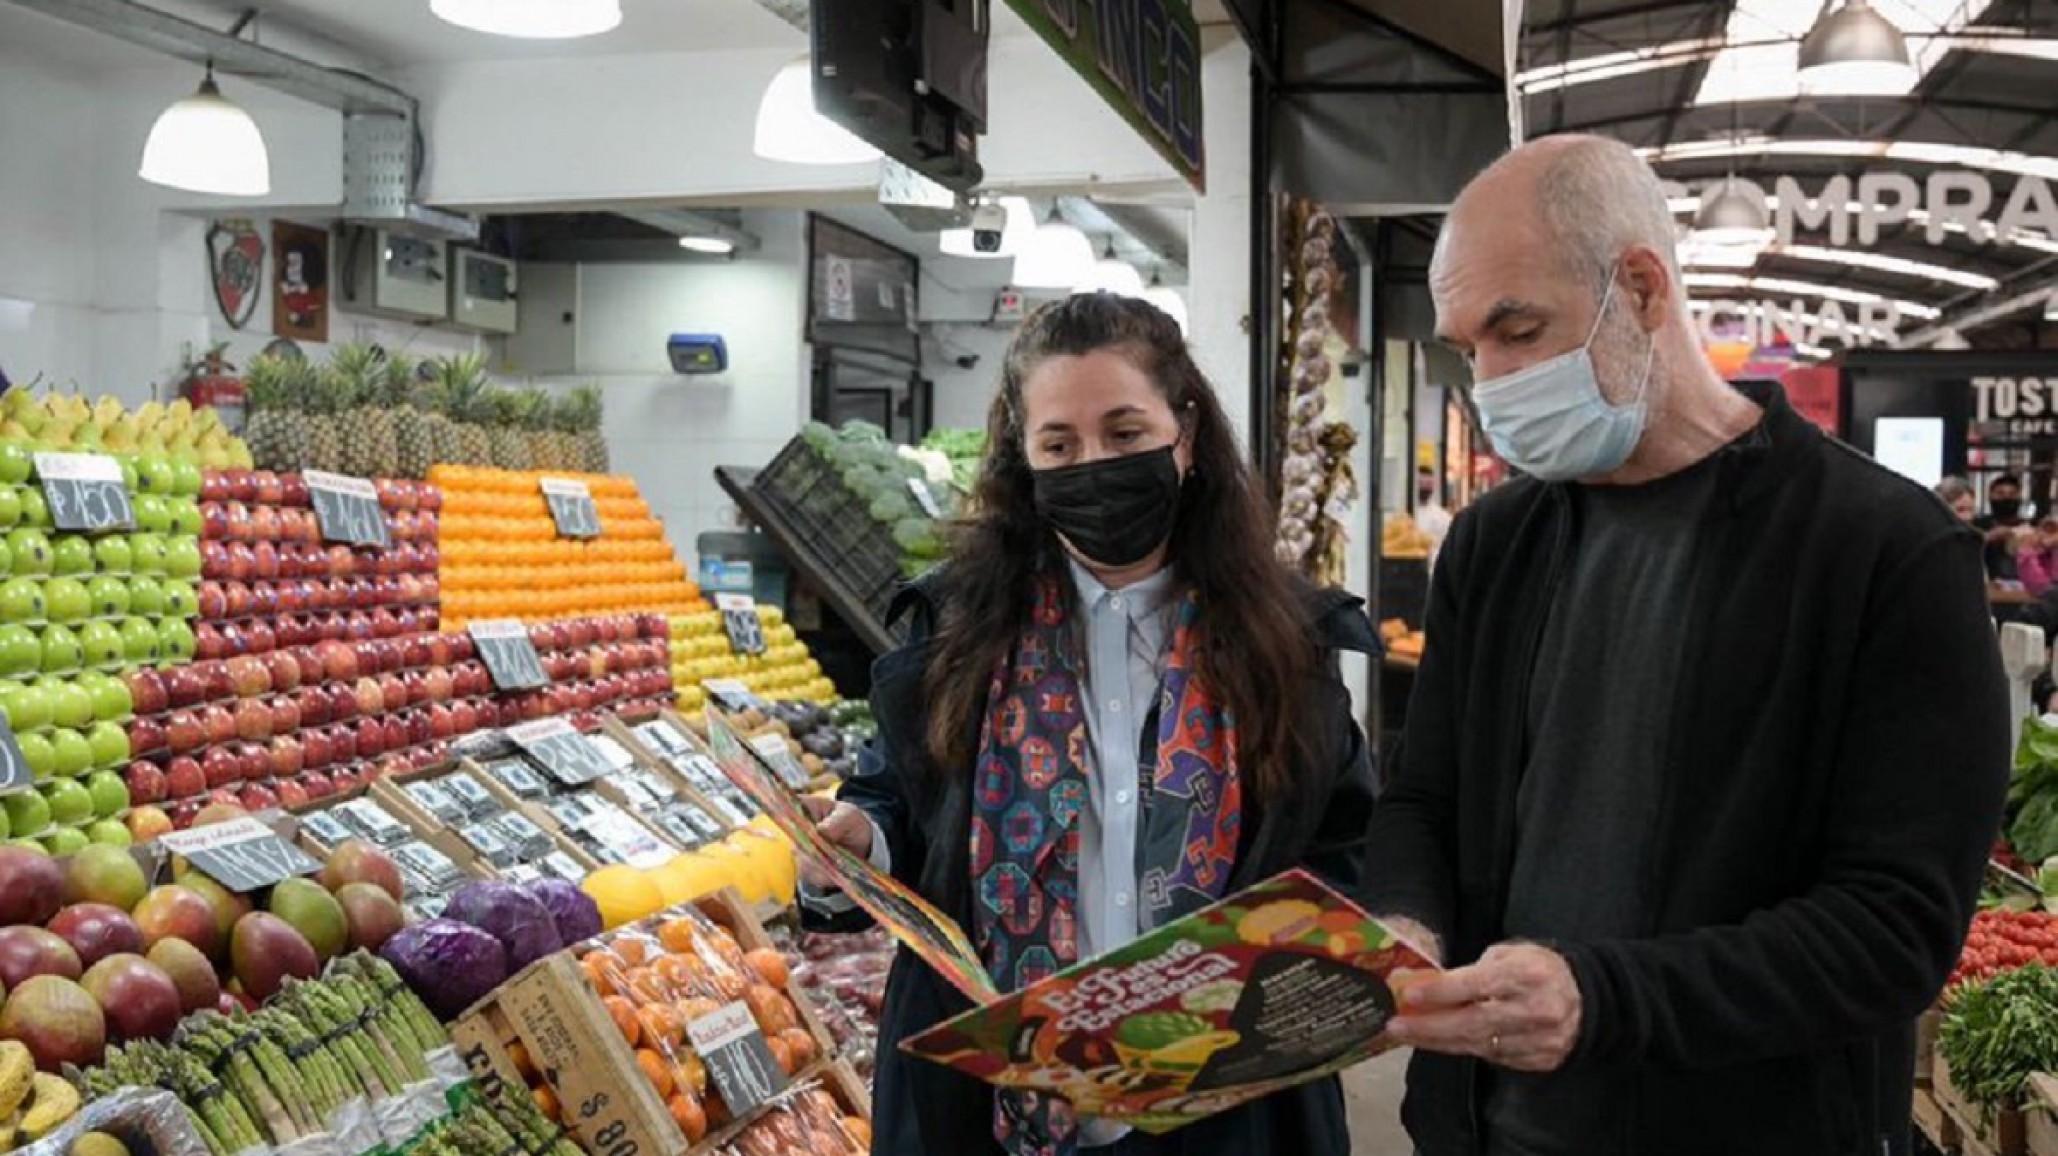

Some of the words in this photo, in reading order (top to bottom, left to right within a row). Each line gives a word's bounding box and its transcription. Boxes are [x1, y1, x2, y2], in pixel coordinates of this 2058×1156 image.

[1701, 299, 1907, 350] CINAR
[1056, 952, 1240, 1032] Estacional
[1078, 938, 1203, 1005] Futuro
